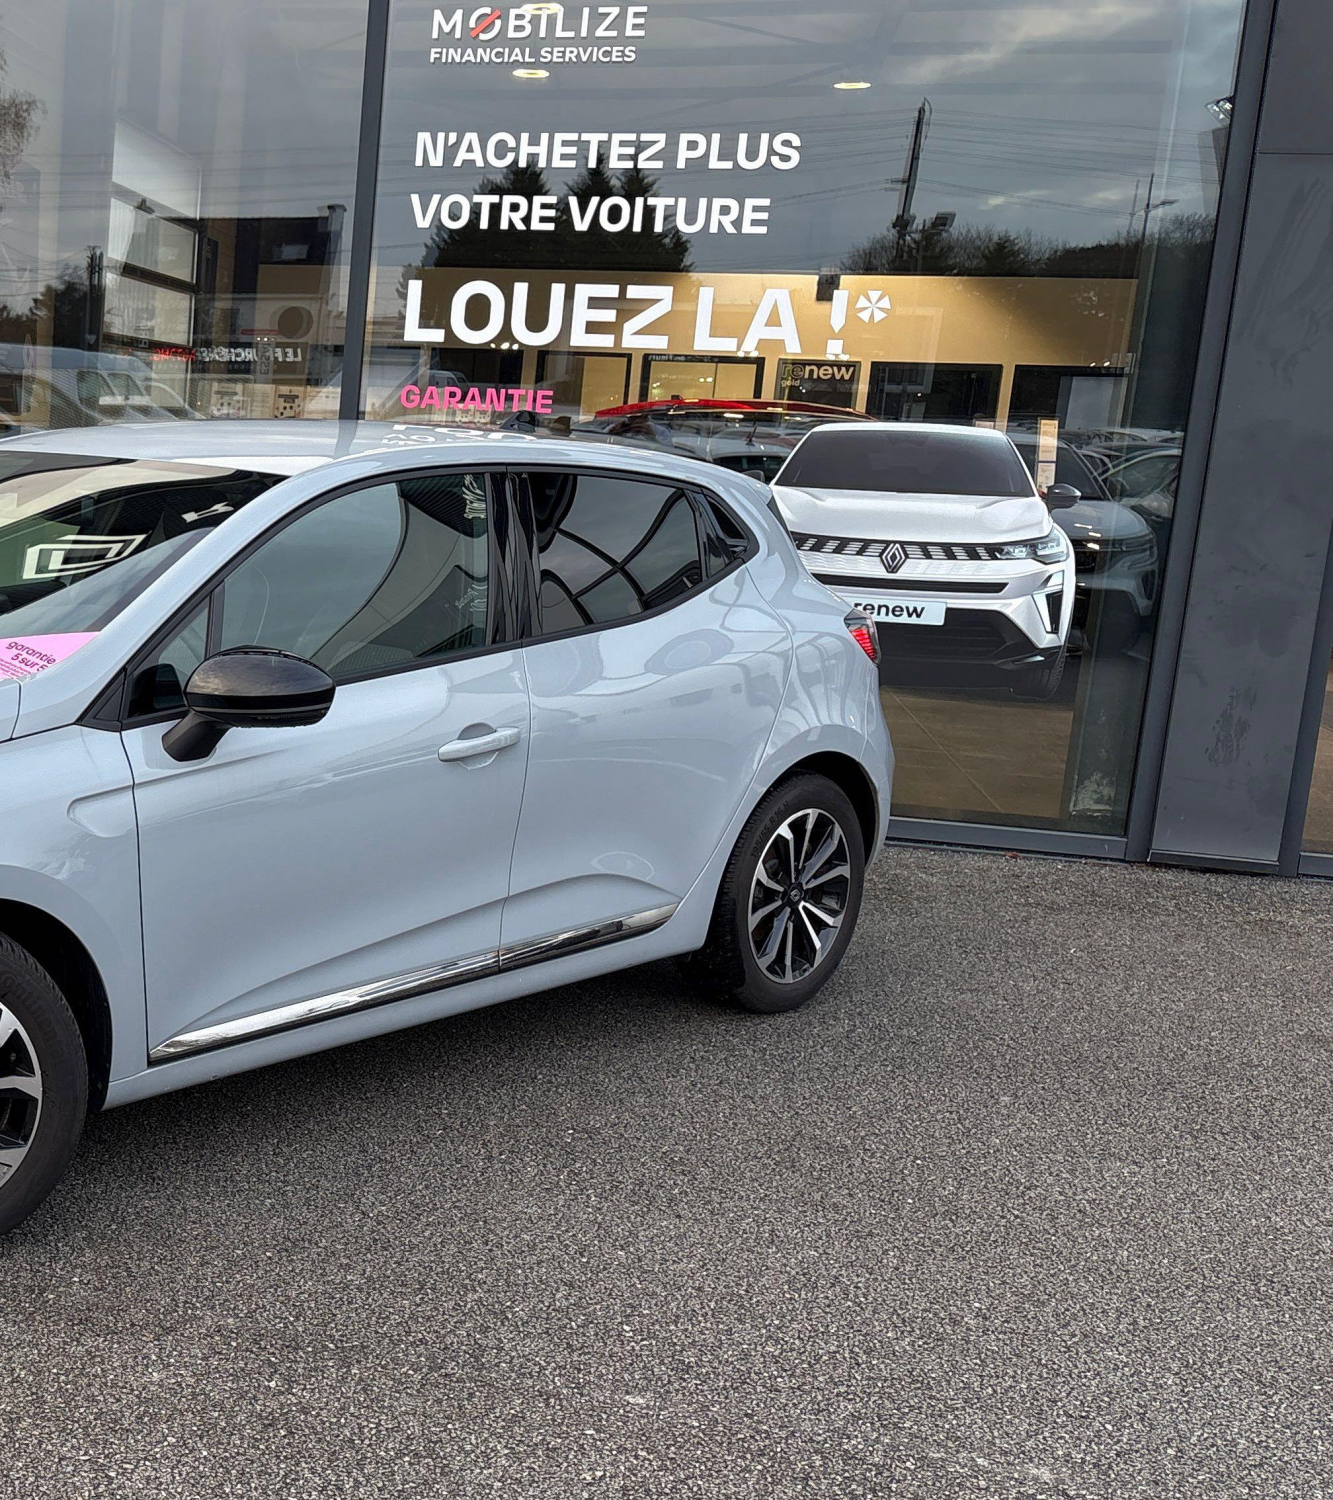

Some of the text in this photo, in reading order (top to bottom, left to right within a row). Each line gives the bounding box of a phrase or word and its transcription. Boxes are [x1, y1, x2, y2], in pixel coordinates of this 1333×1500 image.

[431, 6, 648, 41] MOBILIZE
[429, 46, 637, 63] FINANCIAL SERVICES
[414, 131, 802, 171] N'ACHETEZ PLUS
[409, 192, 771, 235] VOTRE VOITURE
[403, 279, 674, 349] LOUEZ
[693, 286, 802, 355] LA
[781, 378, 800, 387] gold
[782, 364, 854, 380] renew
[400, 384, 554, 414] GARANTIE
[5, 641, 56, 665] garantie
[11, 652, 23, 661] 5
[18, 657, 39, 669] sur
